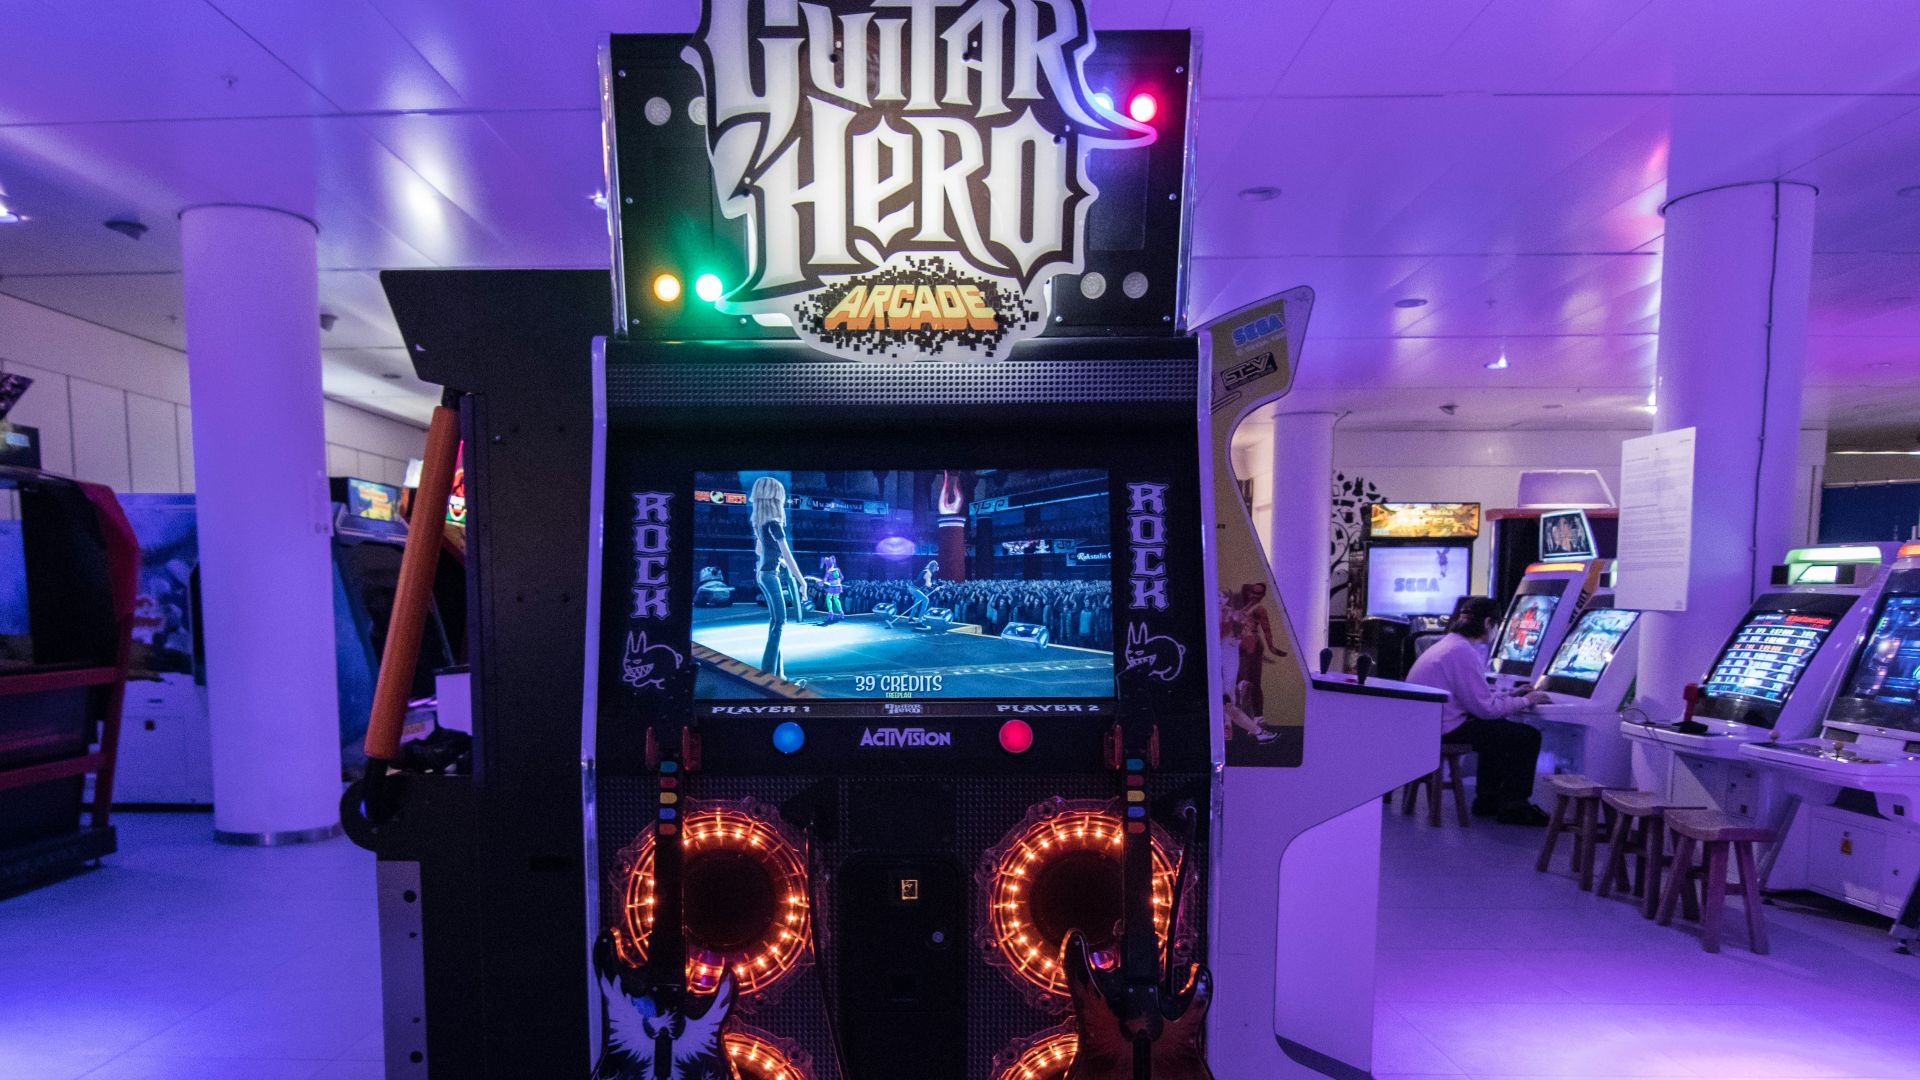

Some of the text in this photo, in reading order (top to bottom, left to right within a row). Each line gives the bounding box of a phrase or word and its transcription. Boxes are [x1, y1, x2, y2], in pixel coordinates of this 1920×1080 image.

[823, 284, 998, 331] ARCADE
[1232, 313, 1286, 348] SEGA
[631, 490, 675, 620] ROCK
[1126, 481, 1169, 612] ROCK
[1393, 578, 1440, 592] SEGA
[855, 675, 943, 692] 39 CREDITS
[712, 706, 798, 714] PLAYER
[997, 704, 1082, 713] PLAYER
[860, 728, 951, 747] ACTIVISION
